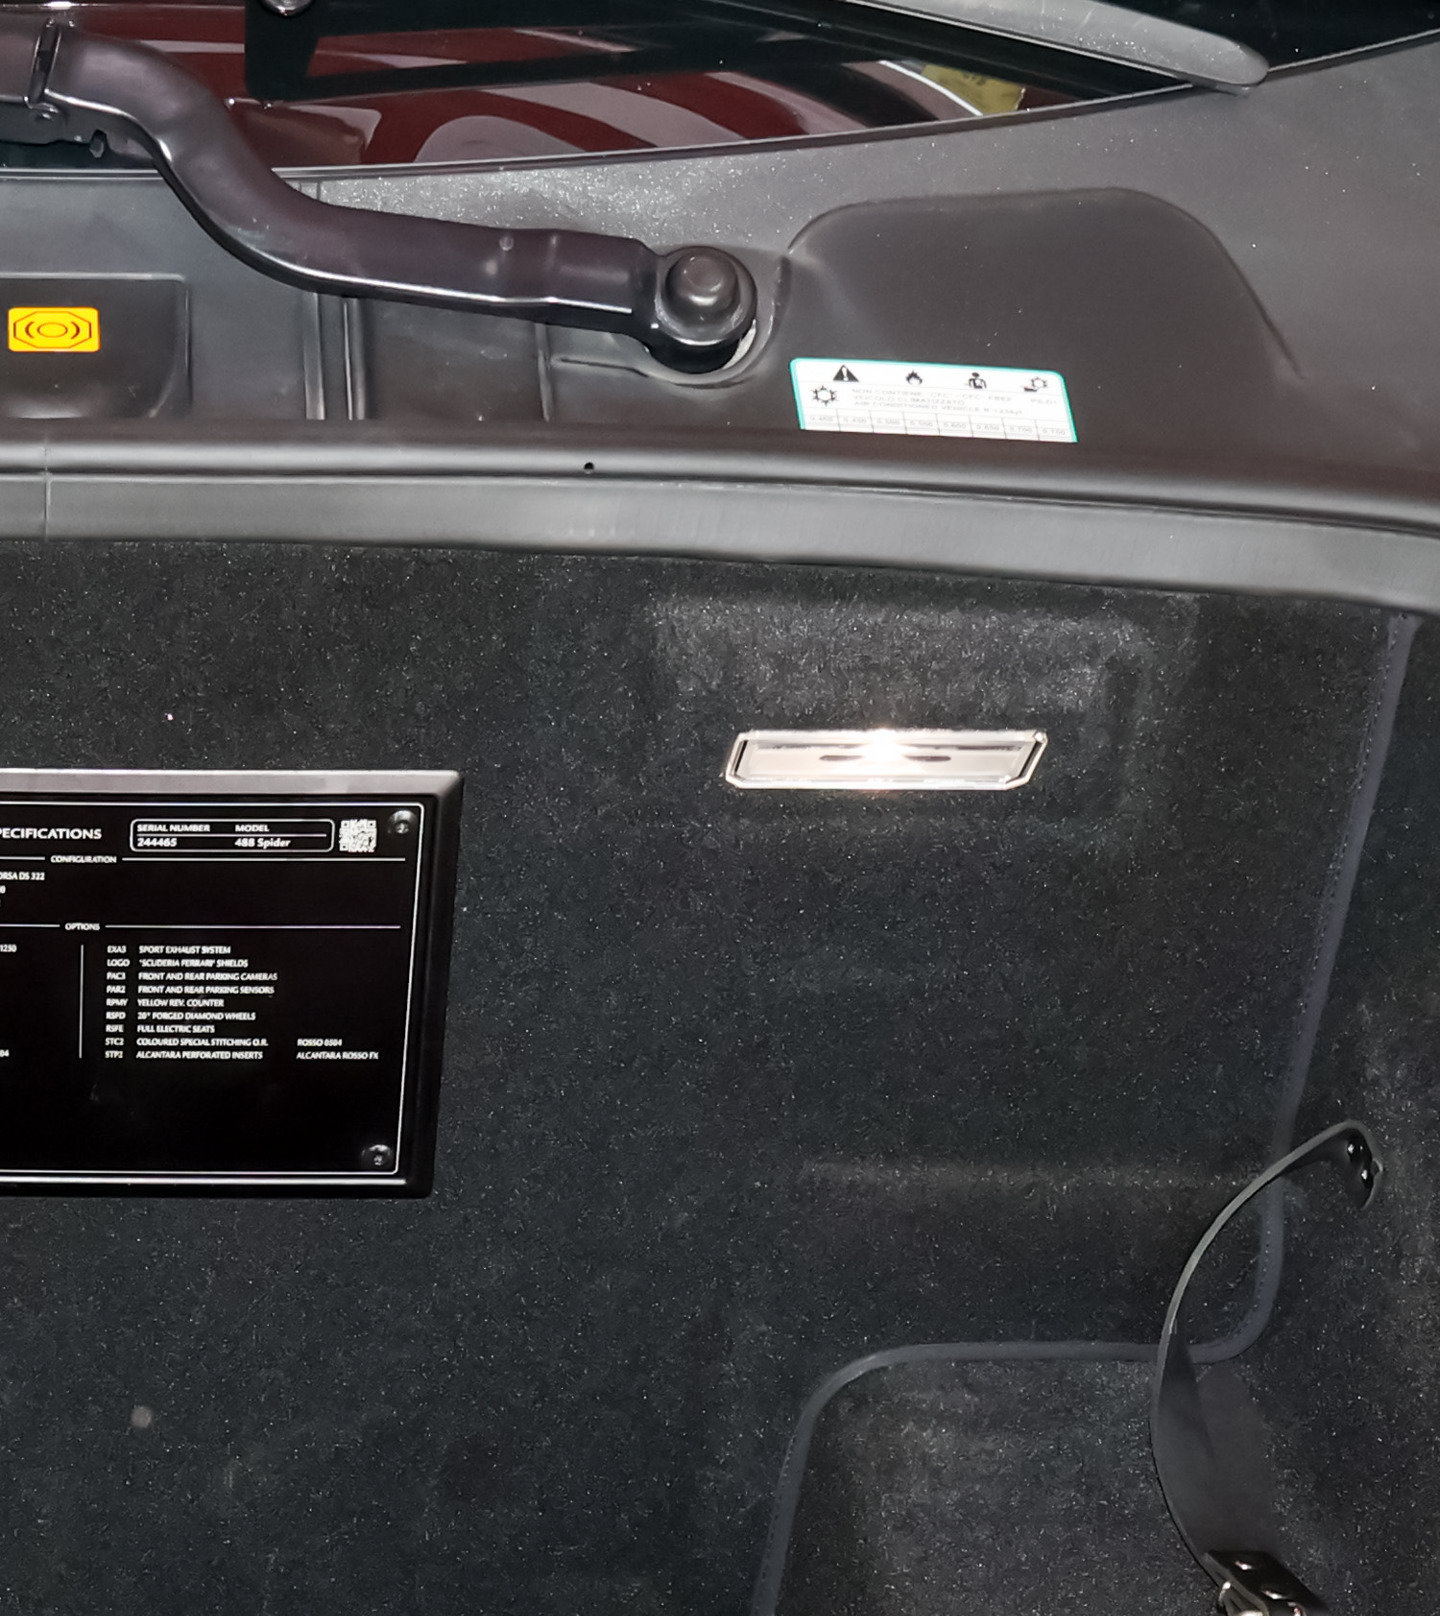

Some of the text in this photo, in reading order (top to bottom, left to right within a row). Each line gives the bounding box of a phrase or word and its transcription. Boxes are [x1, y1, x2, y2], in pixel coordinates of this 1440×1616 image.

[137, 824, 210, 832] SERIAL NUMBER
[235, 824, 269, 832] MODEL
[235, 838, 291, 849] 488 Spider
[51, 855, 116, 863] CONFIGURATION
[19, 872, 30, 880] DS
[31, 872, 44, 880] 322
[166, 946, 200, 954] EXHAUST
[202, 946, 231, 954] SYSTEM
[107, 959, 130, 967] LOGO
[217, 959, 248, 967] SHIELDS
[139, 972, 165, 980] FRONT
[107, 985, 125, 993] PAR2
[184, 986, 204, 994] REAR
[206, 986, 239, 994] PARKING
[240, 986, 274, 994] SENSORS
[187, 999, 224, 1007] COUNTER
[152, 1012, 184, 1020] FORGED
[185, 1012, 224, 1020] DIAMOND
[225, 1012, 255, 1020] WHEELS
[156, 1025, 191, 1033] ELECTRIC
[193, 1025, 215, 1033] SEATS
[137, 1038, 179, 1046] COLOURED
[180, 1038, 210, 1046] SPECIAL
[211, 1038, 251, 1046] STITCHING
[182, 1051, 231, 1059] PERFORATED
[232, 1051, 263, 1059] INSERTS
[297, 1051, 341, 1059] ALCANTARA
